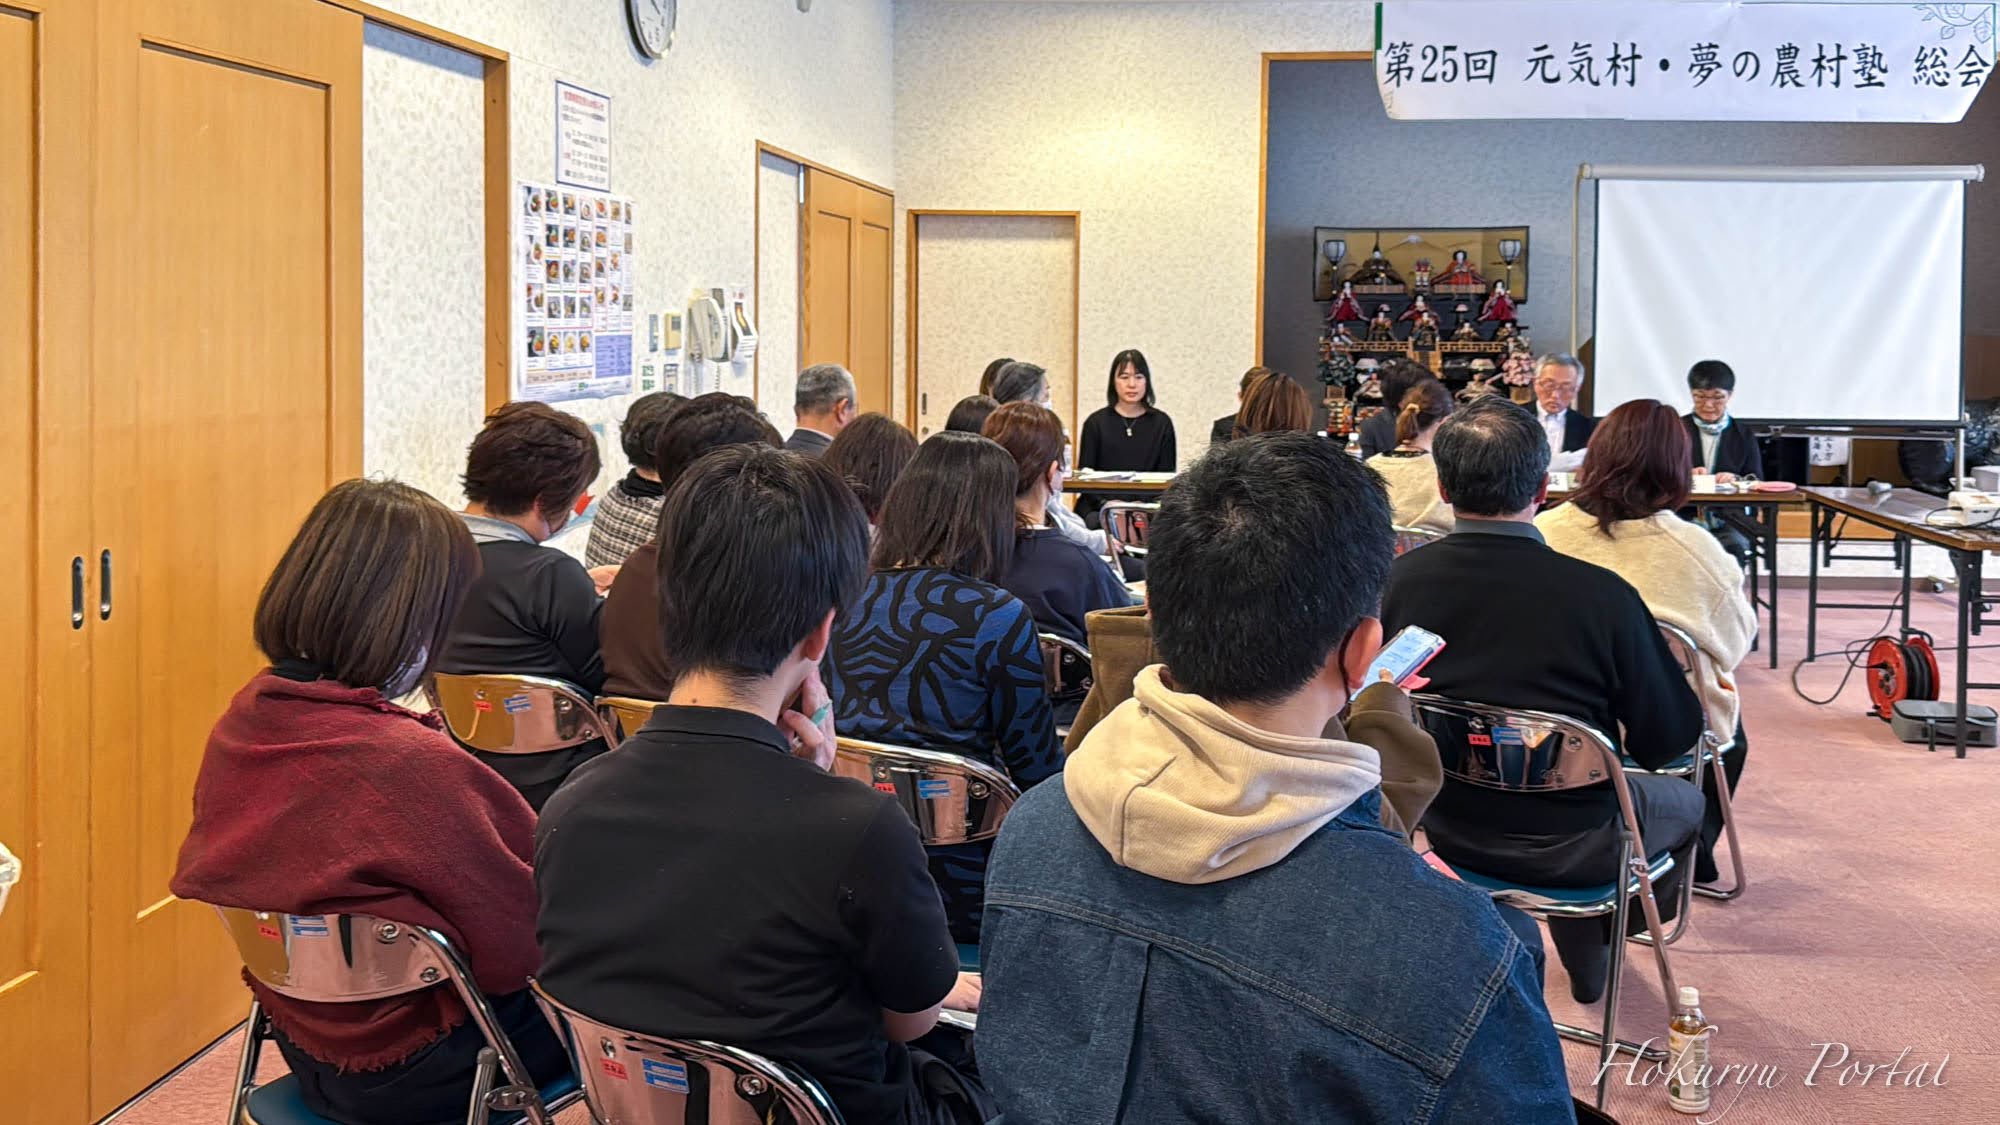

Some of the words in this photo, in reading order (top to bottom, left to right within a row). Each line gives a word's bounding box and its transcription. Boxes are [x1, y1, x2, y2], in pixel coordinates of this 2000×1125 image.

[1383, 41, 1497, 88] 第25回
[1522, 41, 1888, 89] 元気村・夢の農村塾
[1912, 44, 1992, 87] 総会
